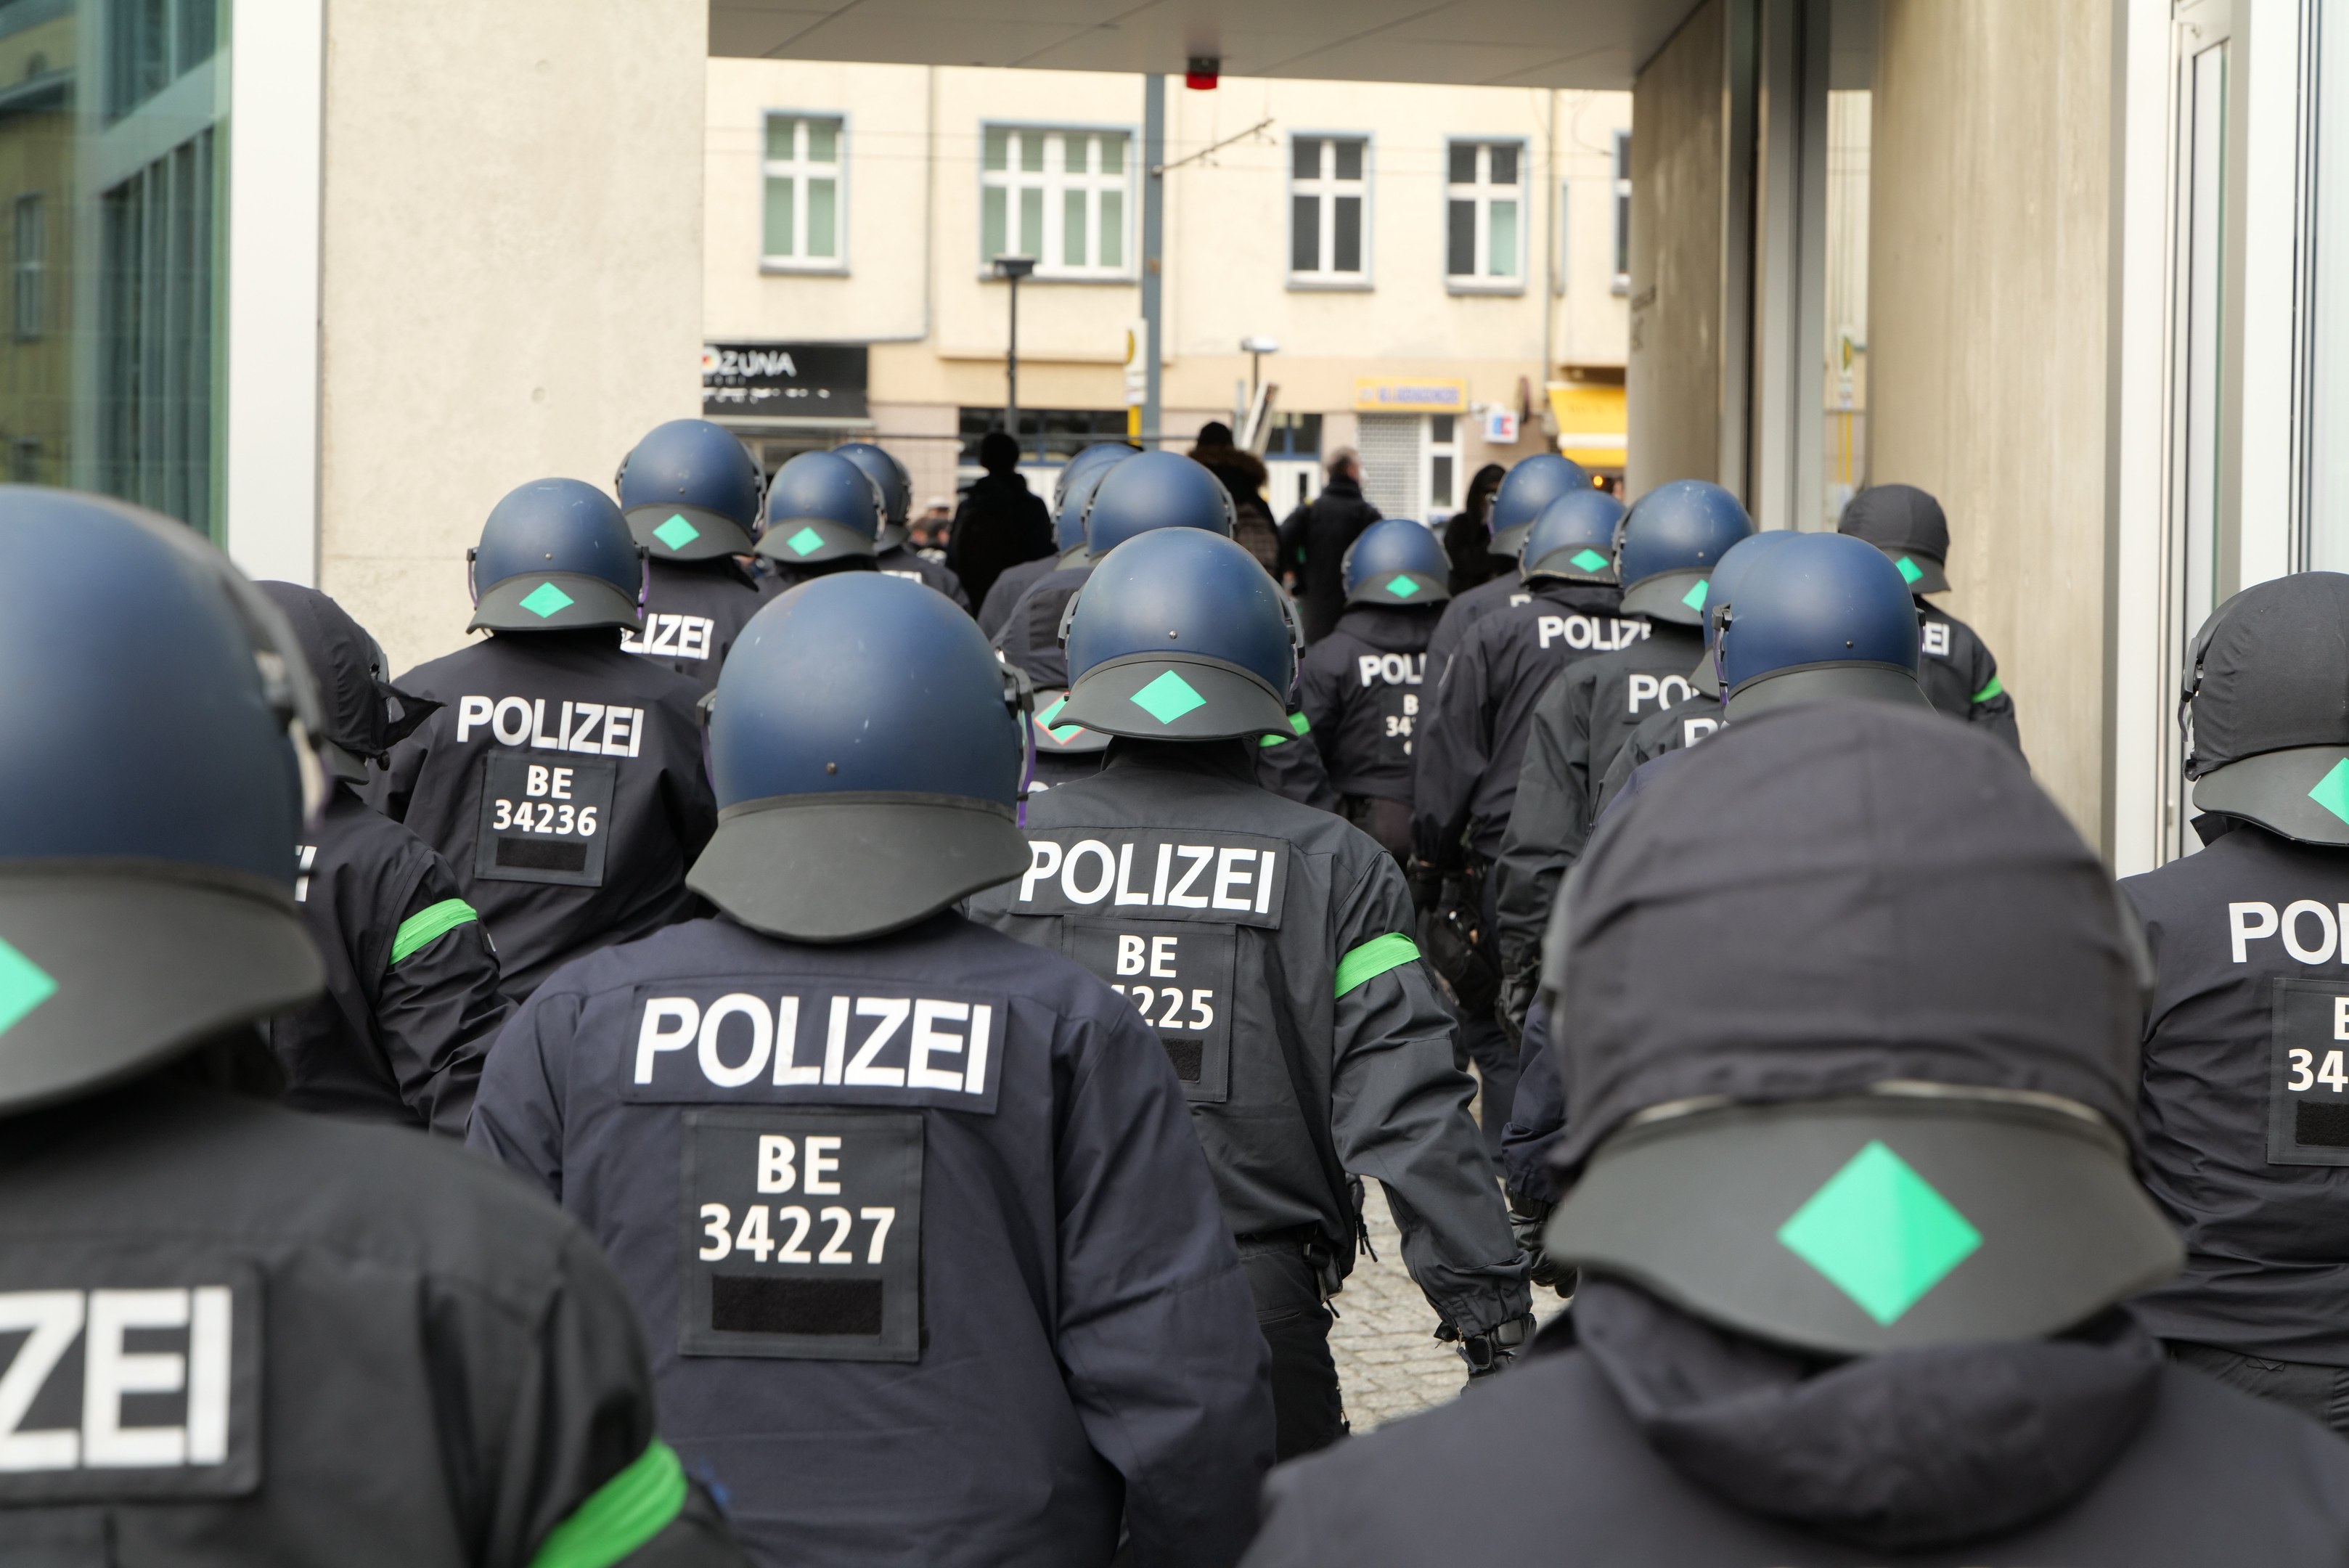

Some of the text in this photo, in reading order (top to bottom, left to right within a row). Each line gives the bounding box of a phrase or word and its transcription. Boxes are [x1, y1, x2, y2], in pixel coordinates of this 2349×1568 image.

[457, 695, 644, 758] POLIZEI
[526, 764, 573, 800] BE
[493, 799, 597, 837] 34236
[1018, 839, 1275, 914] POLIZEI
[1116, 934, 1177, 978] BE
[1111, 984, 1214, 1030] 225
[634, 993, 992, 1095] POLIZEI
[757, 1135, 841, 1195] BE
[699, 1204, 895, 1265] 34227
